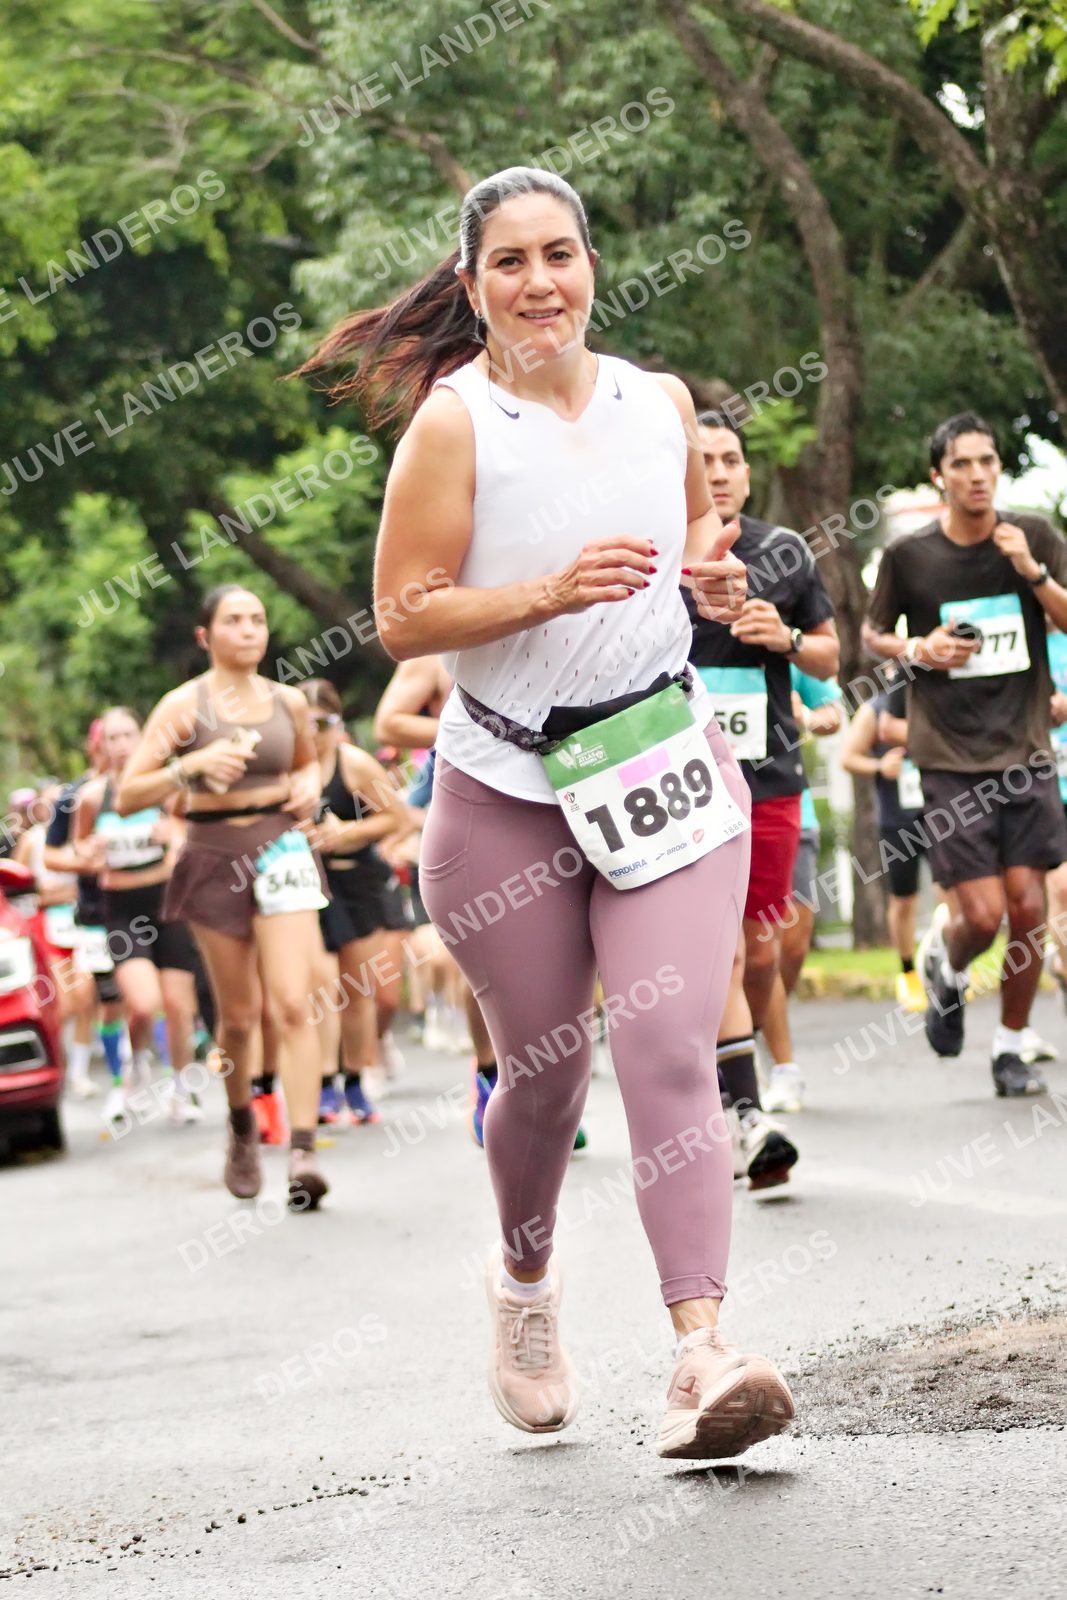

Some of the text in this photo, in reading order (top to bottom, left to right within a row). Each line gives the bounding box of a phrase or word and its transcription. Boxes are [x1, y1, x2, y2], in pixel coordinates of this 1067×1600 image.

[976, 631, 1017, 654] 77
[584, 758, 713, 853] 1889
[723, 821, 744, 836] 1889
[608, 858, 648, 878] PERDURA
